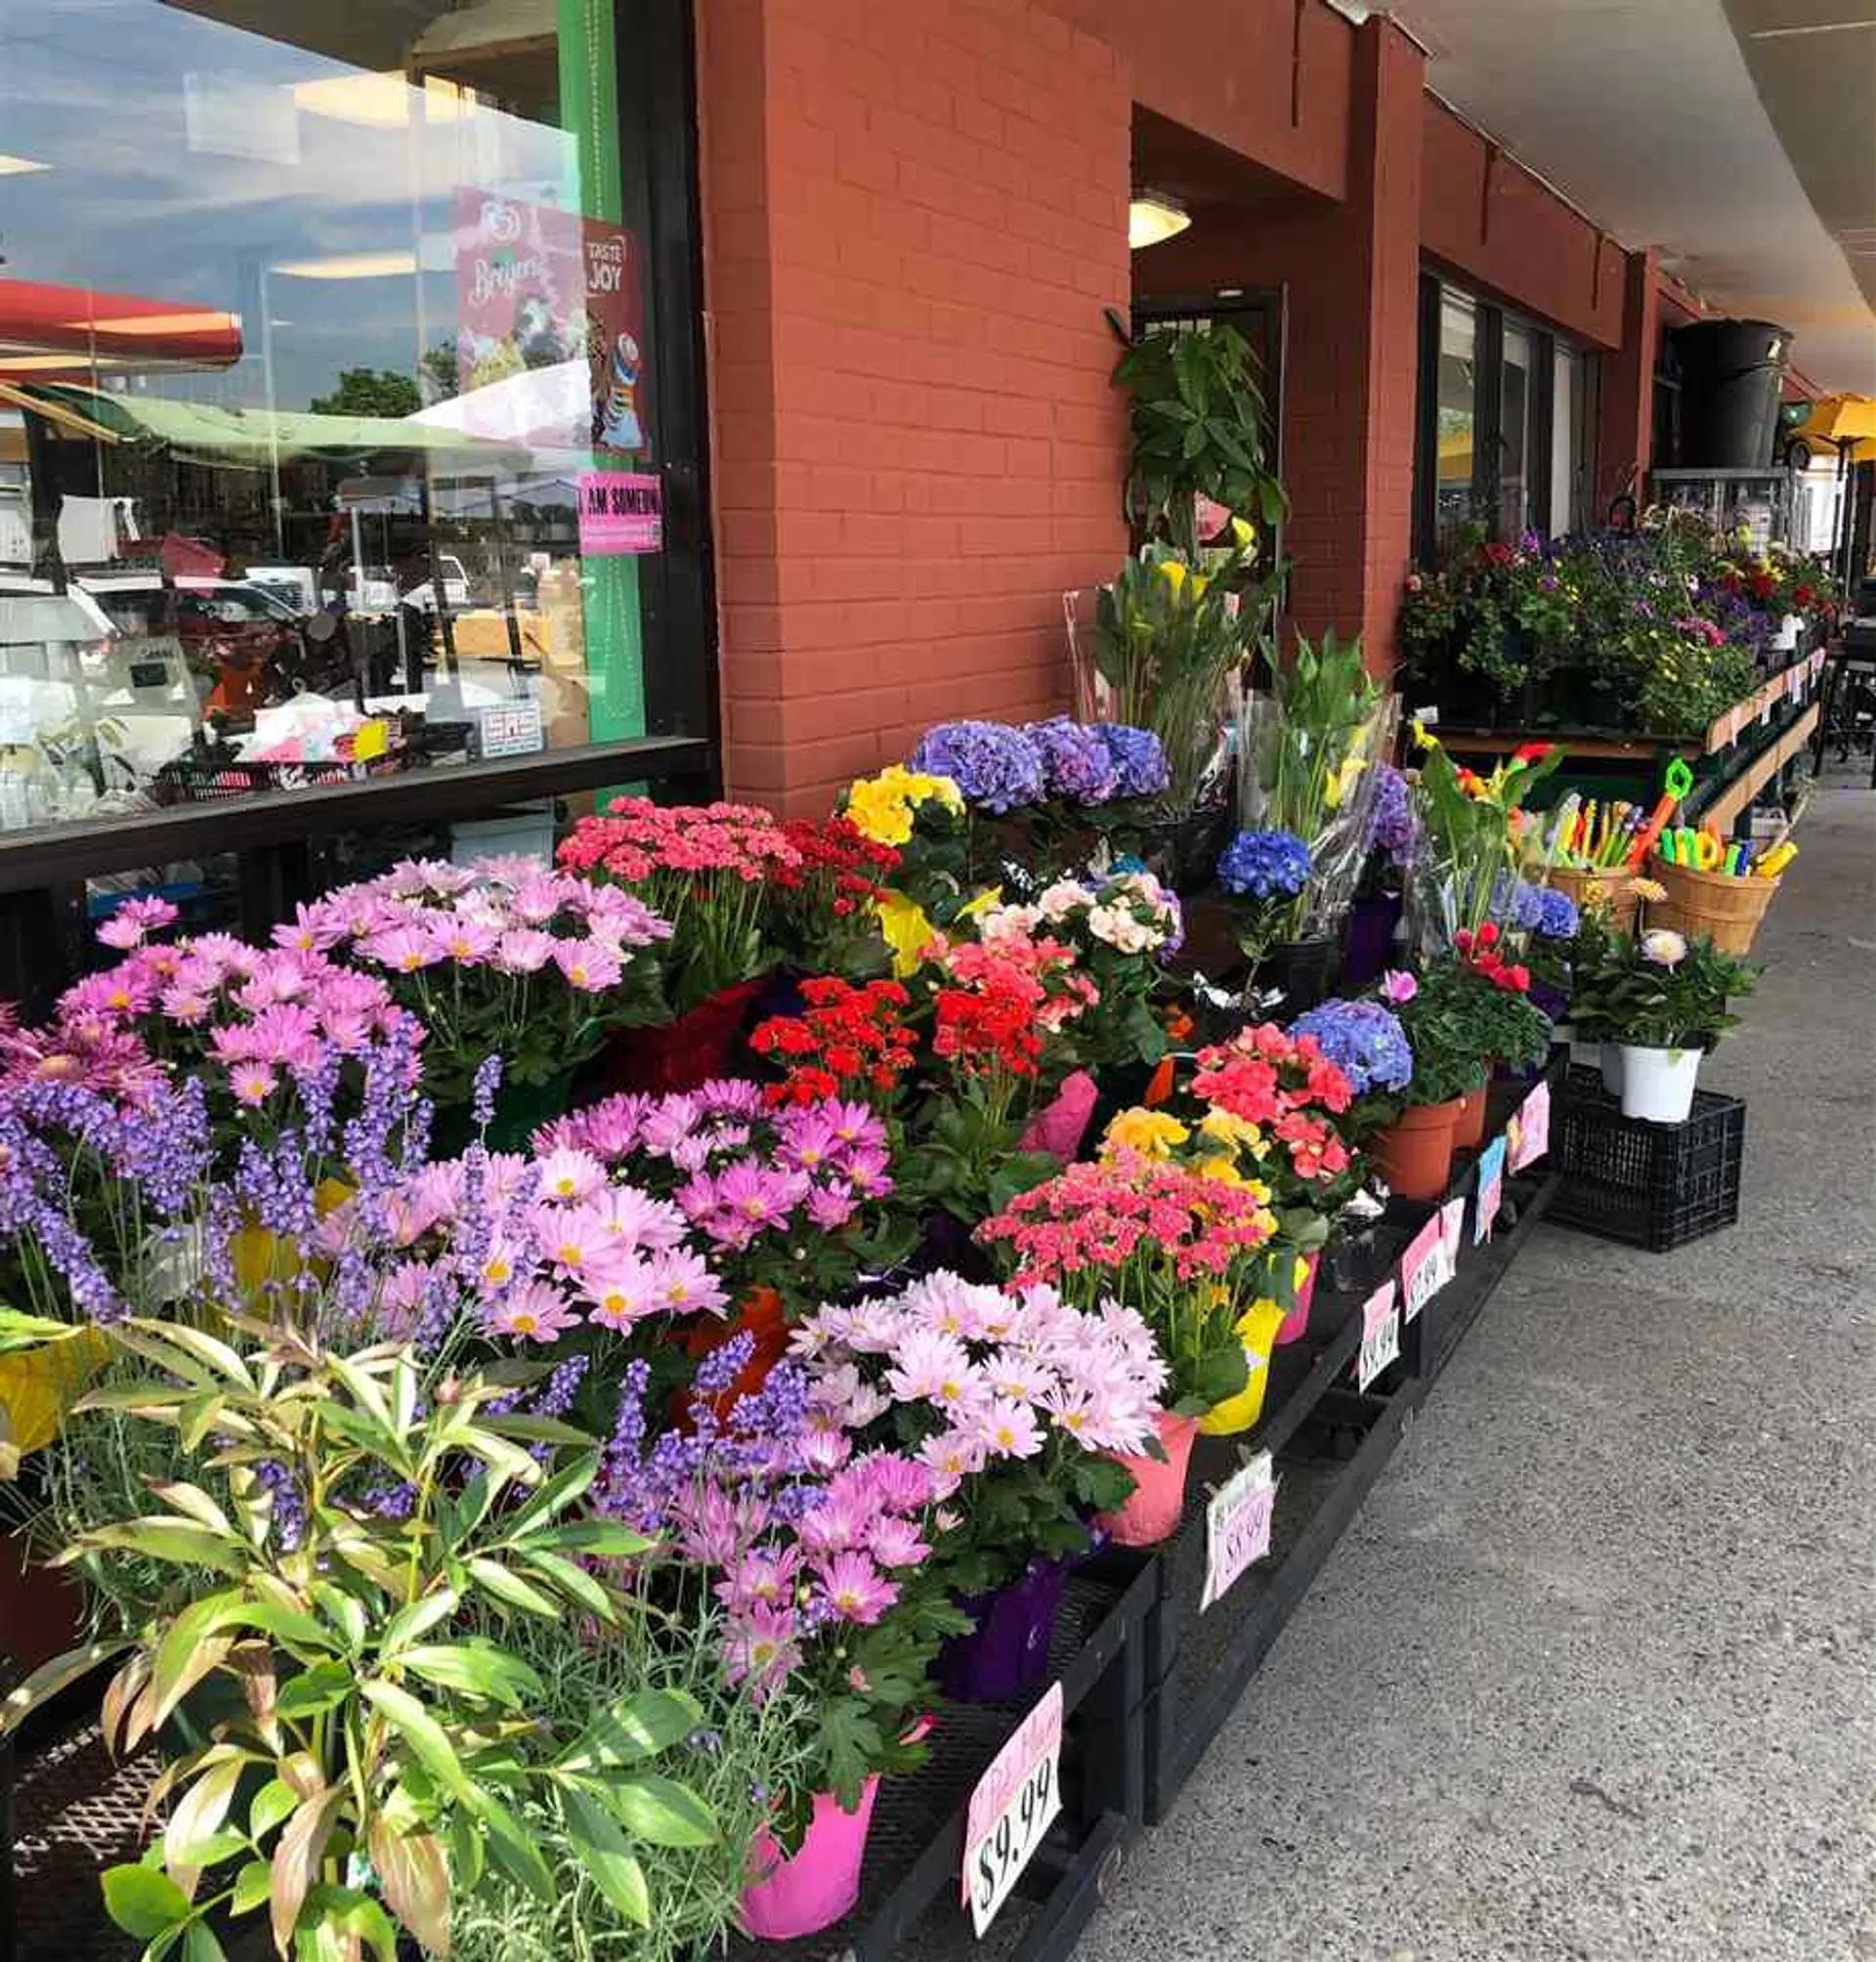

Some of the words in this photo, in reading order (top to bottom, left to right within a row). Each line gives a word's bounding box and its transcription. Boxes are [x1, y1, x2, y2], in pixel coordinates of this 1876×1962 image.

[587, 242, 622, 262] TASTE
[469, 258, 543, 306] Breyer
[588, 261, 622, 291] JOY
[588, 487, 608, 516] AM
[980, 1758, 1051, 1913] $9.99
